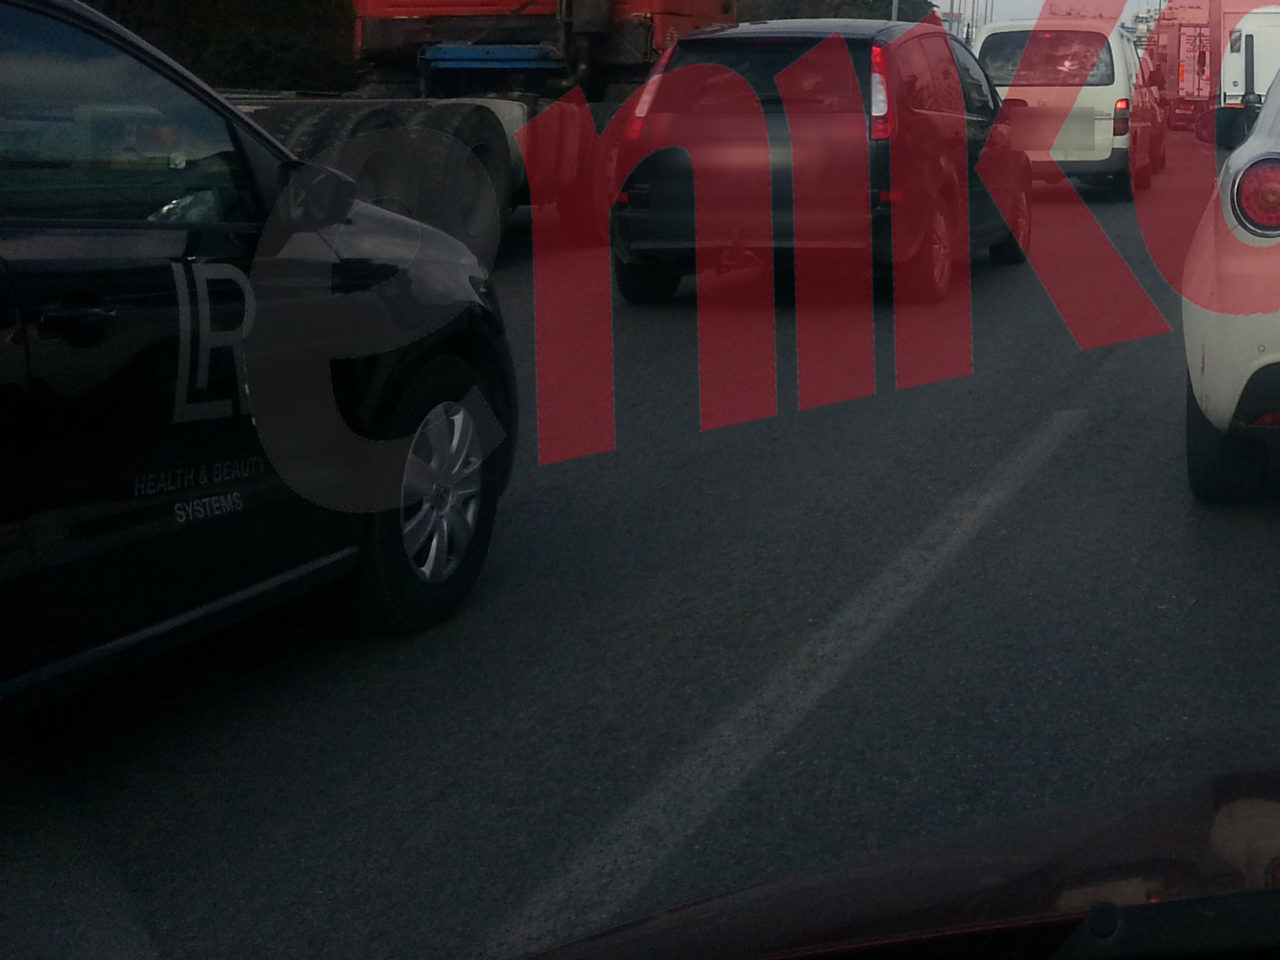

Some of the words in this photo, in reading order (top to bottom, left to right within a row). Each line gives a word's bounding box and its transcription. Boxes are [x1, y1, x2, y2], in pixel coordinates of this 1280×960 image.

[133, 463, 195, 498] HEALTH
[199, 461, 209, 486] &
[212, 454, 267, 484] BEAUTY
[173, 490, 245, 524] SYSTEMS
